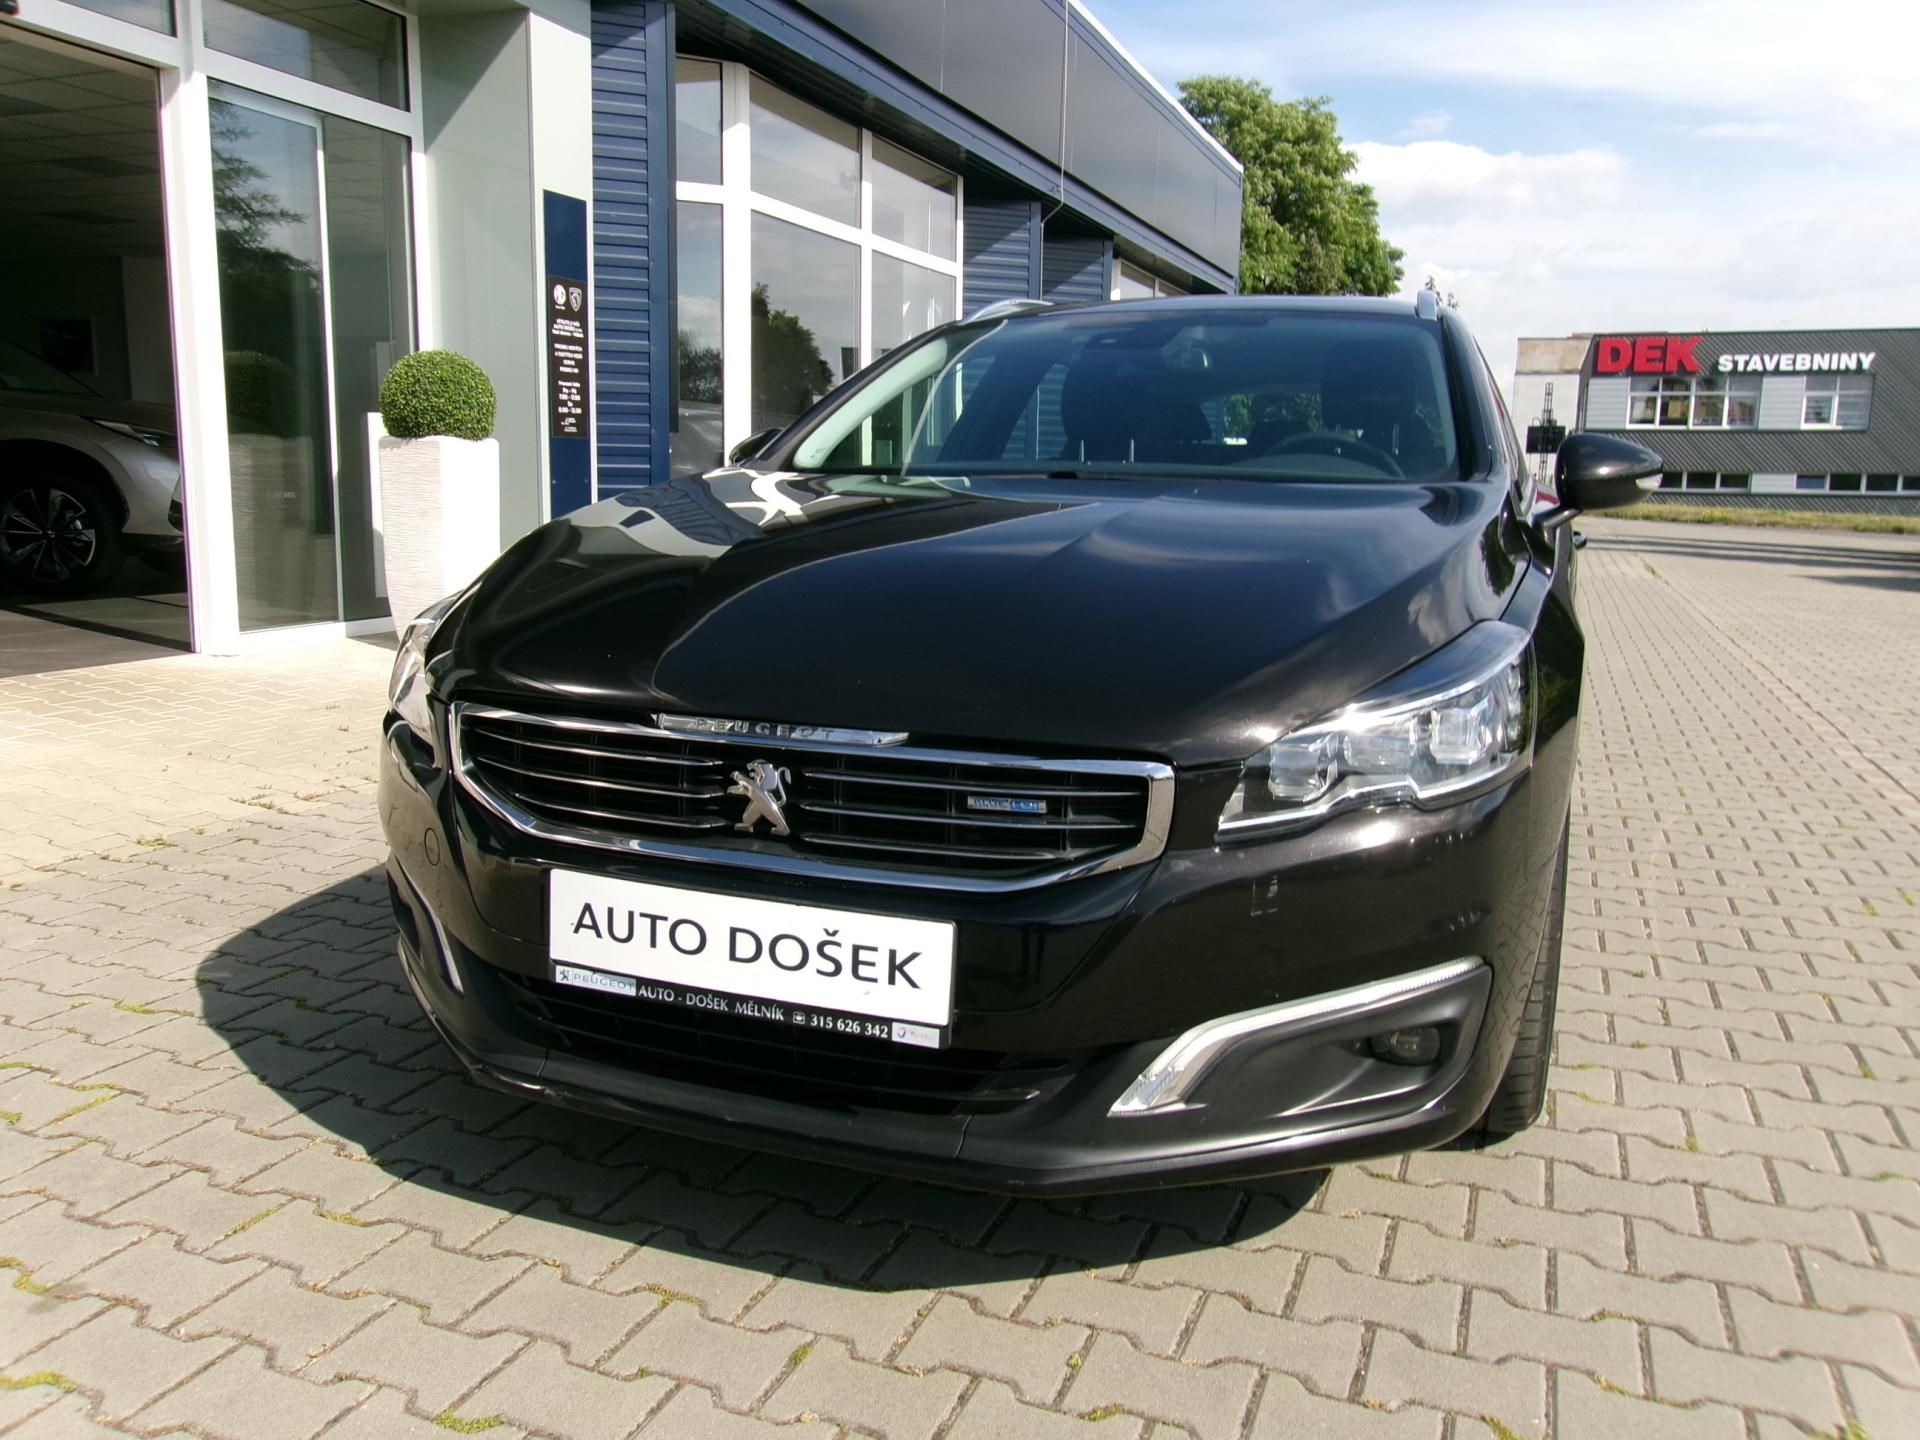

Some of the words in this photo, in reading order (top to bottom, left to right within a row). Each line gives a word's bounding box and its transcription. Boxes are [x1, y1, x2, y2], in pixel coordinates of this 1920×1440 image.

[1597, 336, 1703, 373] DEK
[1718, 353, 1876, 372] STAVEBNINY
[695, 717, 834, 739] PEUGEOT
[573, 902, 707, 955] AUTO
[729, 927, 921, 989] DOŠEK
[574, 973, 634, 992] PEUGEOT
[639, 986, 675, 1002] AUTO
[686, 993, 729, 1012] DOŠEK
[735, 1000, 785, 1021] MĚLNÍK
[811, 1014, 834, 1029] 315
[837, 1018, 861, 1034] 626
[865, 1022, 889, 1039] 342
